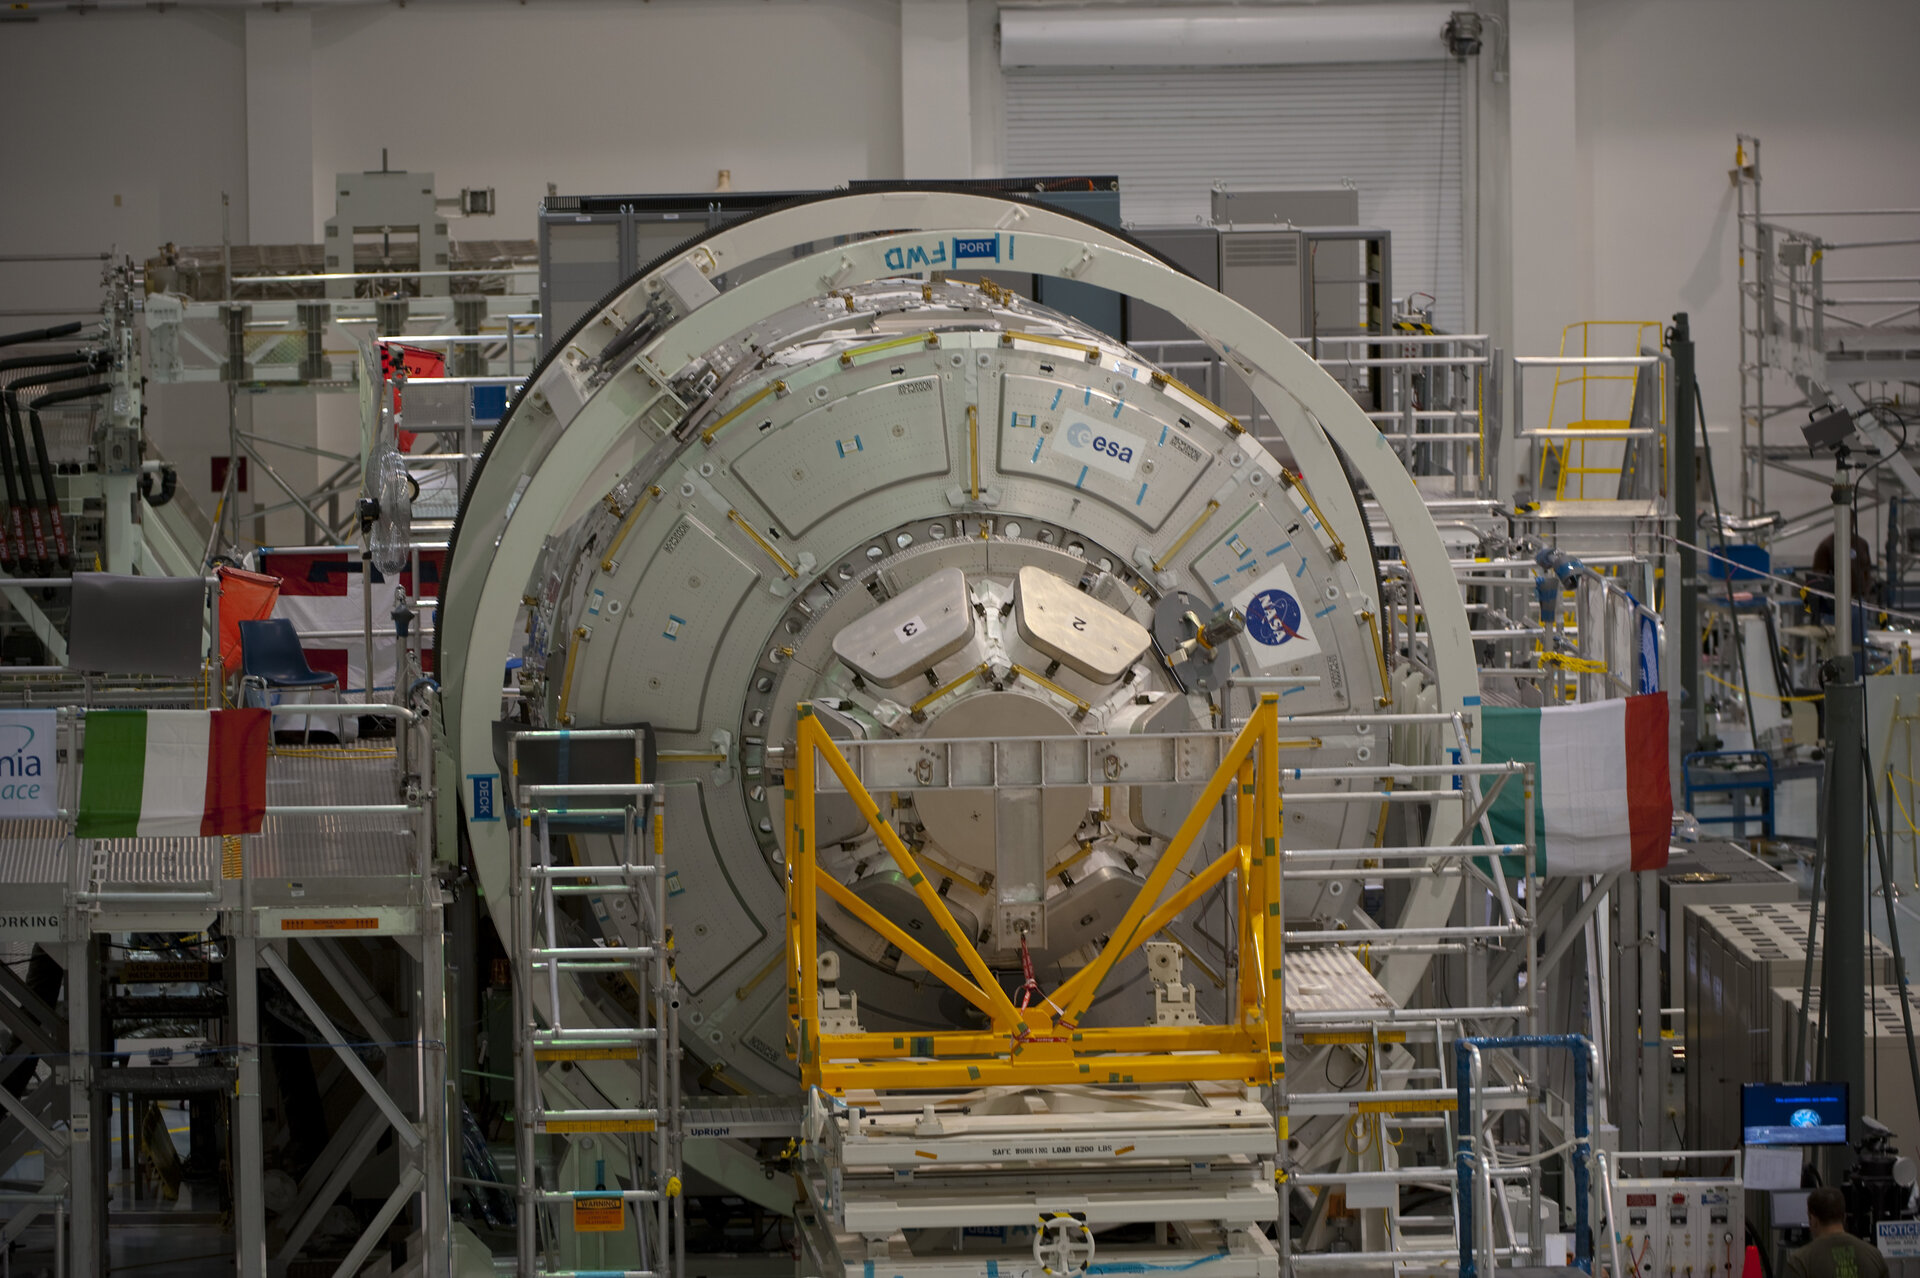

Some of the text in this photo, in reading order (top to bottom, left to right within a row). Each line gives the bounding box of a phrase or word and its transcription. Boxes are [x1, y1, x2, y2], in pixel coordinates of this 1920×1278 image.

[884, 240, 947, 271] FWD
[959, 242, 993, 254] PORT
[1092, 436, 1134, 464] esa
[1072, 616, 1087, 632] 2
[1258, 593, 1286, 644] NASA
[902, 622, 918, 637] 3
[479, 781, 491, 814] DECK
[908, 918, 924, 930] 5
[690, 1127, 730, 1137] UpRight
[992, 1148, 1011, 1156] SAFE
[1015, 1147, 1048, 1155] WORKING
[1052, 1146, 1071, 1154] LOAD
[581, 1199, 617, 1208] WARNING
